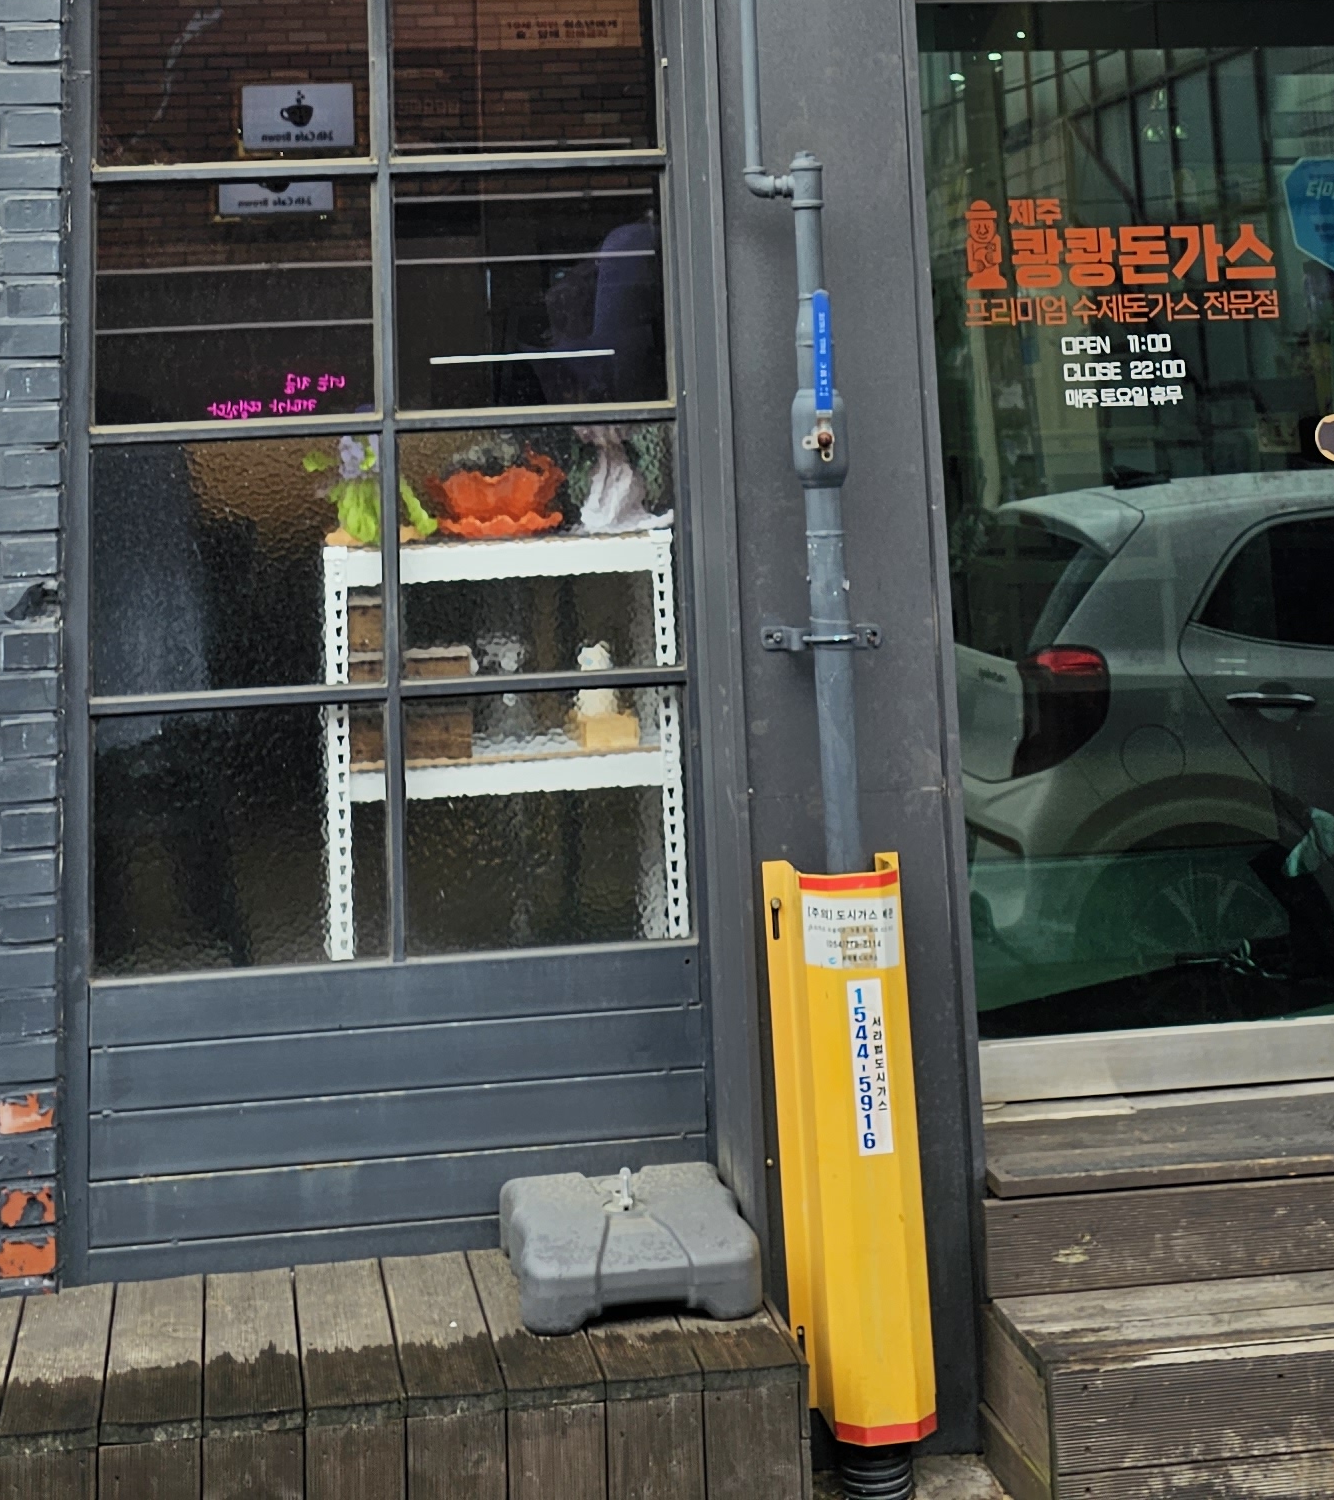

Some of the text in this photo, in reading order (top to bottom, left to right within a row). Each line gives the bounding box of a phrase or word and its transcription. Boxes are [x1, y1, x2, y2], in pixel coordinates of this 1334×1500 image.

[1008, 198, 1061, 227] 제주
[1011, 223, 1277, 288] 쾅쾅돈가스
[965, 290, 1279, 327] 프리미엄 수제돈가스 전문점
[1061, 334, 1171, 355] OPEN 11:00
[1063, 359, 1186, 382] CLOSE 22:00
[1065, 385, 1183, 408] 매주 토요일 휴무
[836, 909, 878, 921] 도시가스
[853, 988, 876, 1149] 1544-5916
